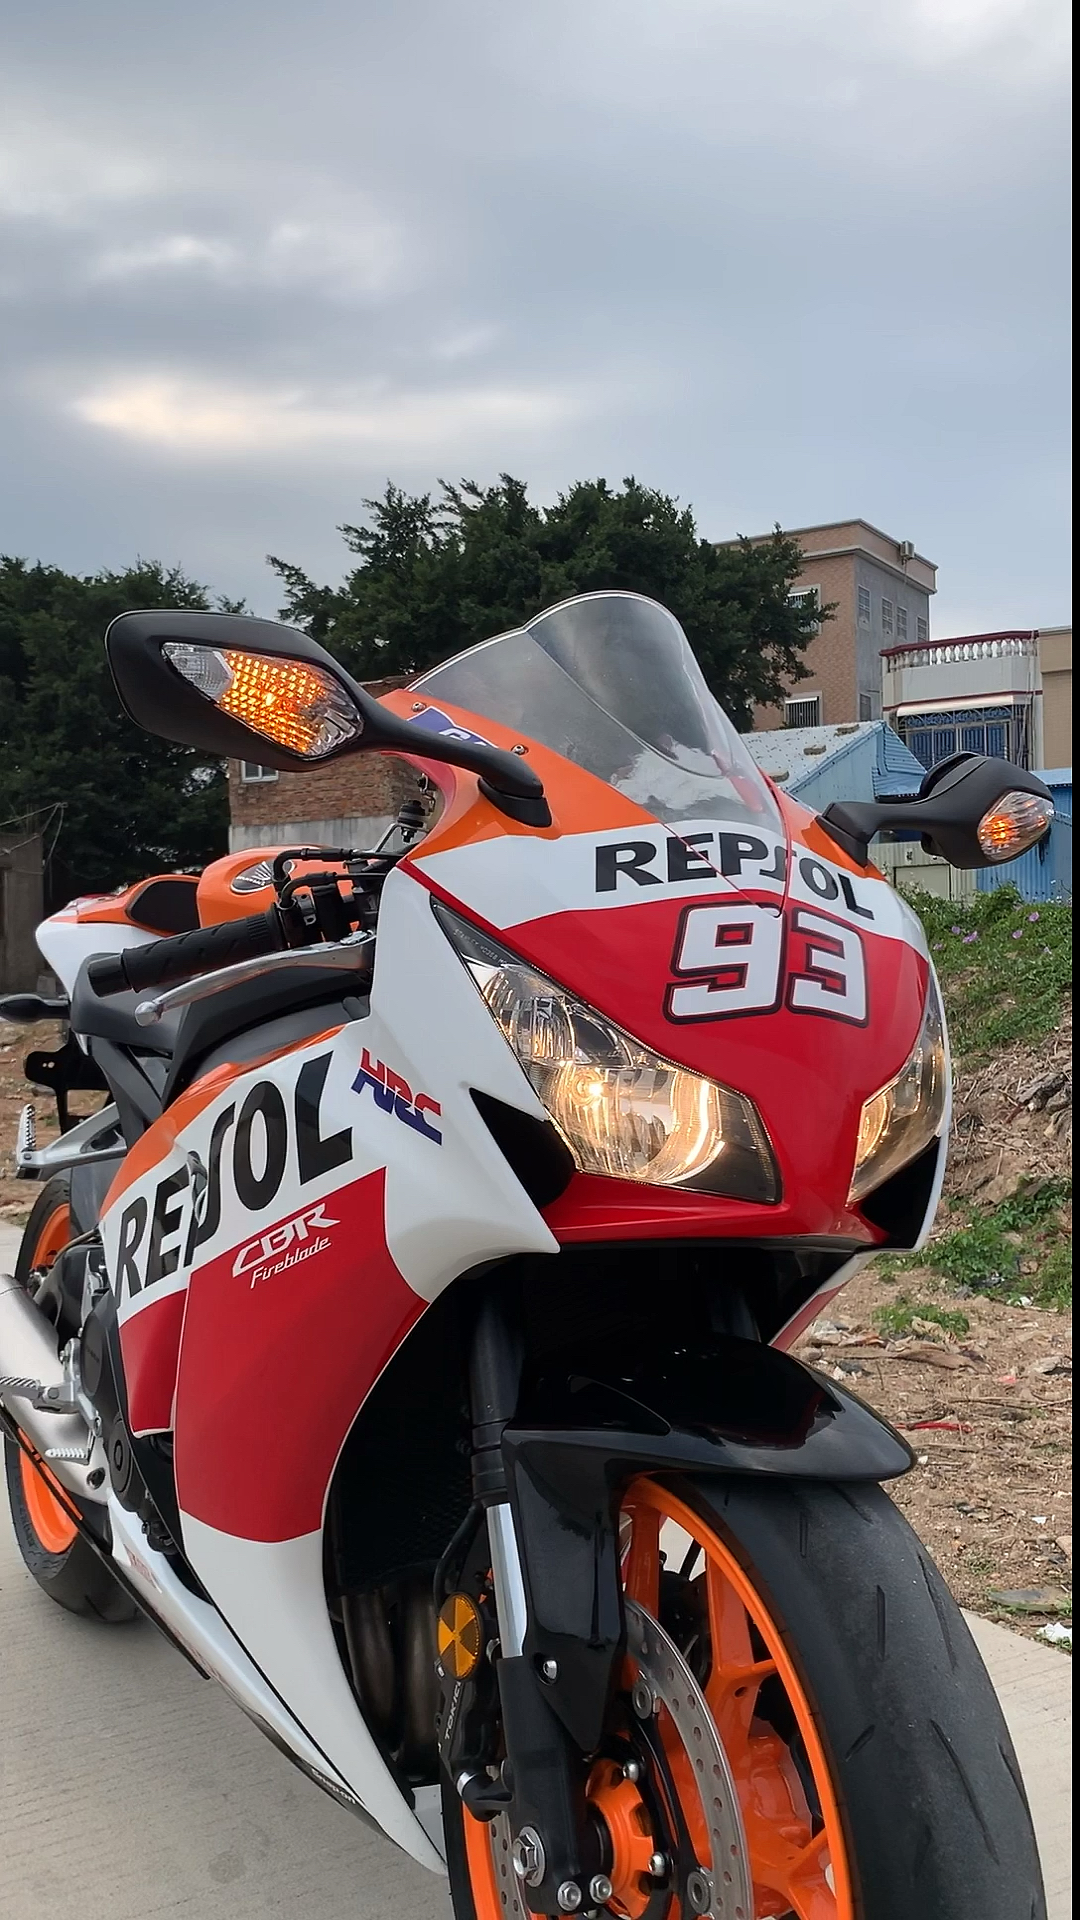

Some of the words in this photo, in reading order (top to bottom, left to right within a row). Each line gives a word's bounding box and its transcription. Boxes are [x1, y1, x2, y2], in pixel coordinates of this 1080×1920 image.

[594, 831, 876, 921] REPSOL
[662, 900, 870, 1029] 93
[350, 1046, 443, 1147] HRC
[113, 1049, 354, 1300] REPSOL
[232, 1202, 341, 1278] CBR
[250, 1236, 332, 1289] Fireblade
